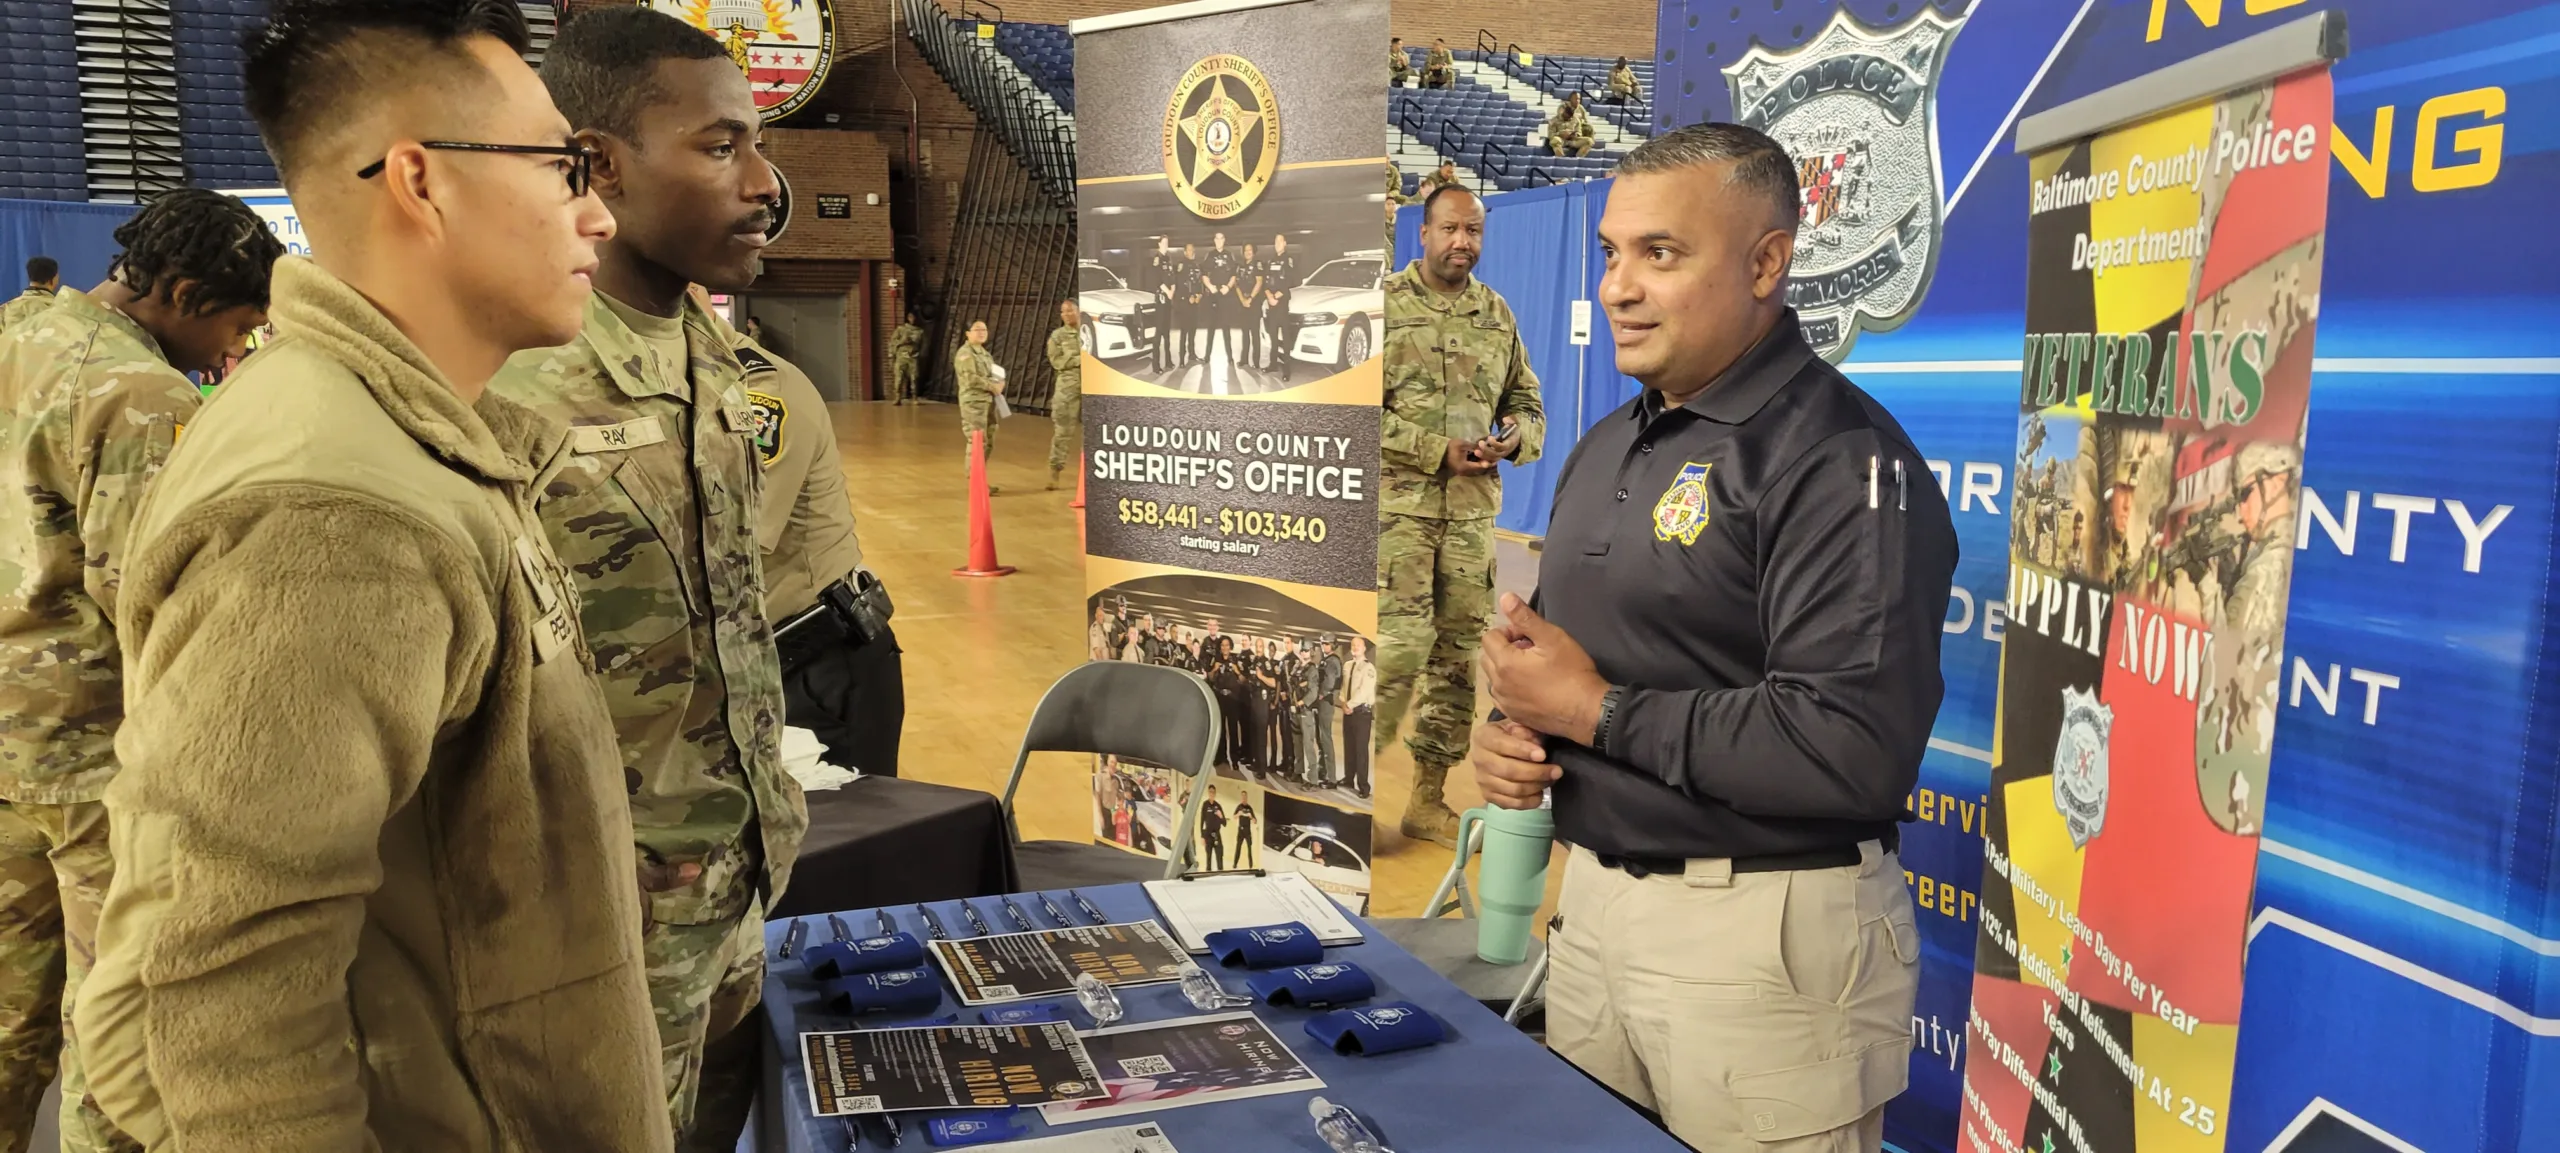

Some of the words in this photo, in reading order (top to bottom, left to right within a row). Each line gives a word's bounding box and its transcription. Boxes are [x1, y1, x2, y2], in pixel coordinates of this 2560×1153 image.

[782, 100, 798, 115] THE
[797, 78, 819, 102] NATION
[816, 53, 829, 77] SINCE
[823, 32, 832, 50] 1802
[1758, 57, 1904, 125] POLICE
[1164, 91, 1184, 157] LOUDOUN
[1183, 58, 1222, 90] COUNTY
[1224, 58, 1268, 98] SHERIFF'S
[1264, 99, 1277, 150] OFFICE
[2032, 168, 2120, 215] Baltimore
[2126, 143, 2209, 194] County
[2214, 121, 2316, 175] Police
[1197, 200, 1242, 215] VIRGINIA
[2071, 217, 2205, 279] Department
[2022, 330, 2268, 429] VETERANS
[600, 427, 626, 446] RAY
[1102, 424, 1221, 452] LOUDOUN
[1235, 432, 1351, 460] COUNTY
[1093, 450, 1234, 491] SHERIFF'S
[1244, 461, 1363, 501] OFFICE
[1679, 472, 1705, 481] POLICE
[1118, 498, 1198, 530] $58,441
[1219, 508, 1327, 543] $103,340
[1180, 535, 1221, 553] starting
[1222, 541, 1260, 557] salary
[2005, 563, 2111, 657] APPLY
[2119, 601, 2214, 701] NOW
[1104, 953, 1148, 976] NOW
[1989, 842, 2009, 880] Paid
[2010, 863, 2057, 919] Military
[2058, 899, 2093, 948] Leave
[2094, 931, 2121, 979] Days
[2123, 961, 2148, 1002] Per
[2150, 984, 2199, 1036] Year
[1985, 909, 2003, 946] 12%
[2004, 928, 2017, 958] In
[2018, 944, 2079, 1015] Additional
[2080, 998, 2145, 1092] Retirement
[2149, 1076, 2172, 1112] At
[2178, 1096, 2216, 1136] 25
[2042, 999, 2075, 1053] Years
[1235, 1042, 1274, 1073] HIRING
[1252, 1040, 1282, 1060] NOW
[1982, 1019, 2001, 1060] Pay
[2002, 1042, 2067, 1131] Differential
[957, 1059, 1009, 1104] HIRING
[998, 1064, 1044, 1093] NOW
